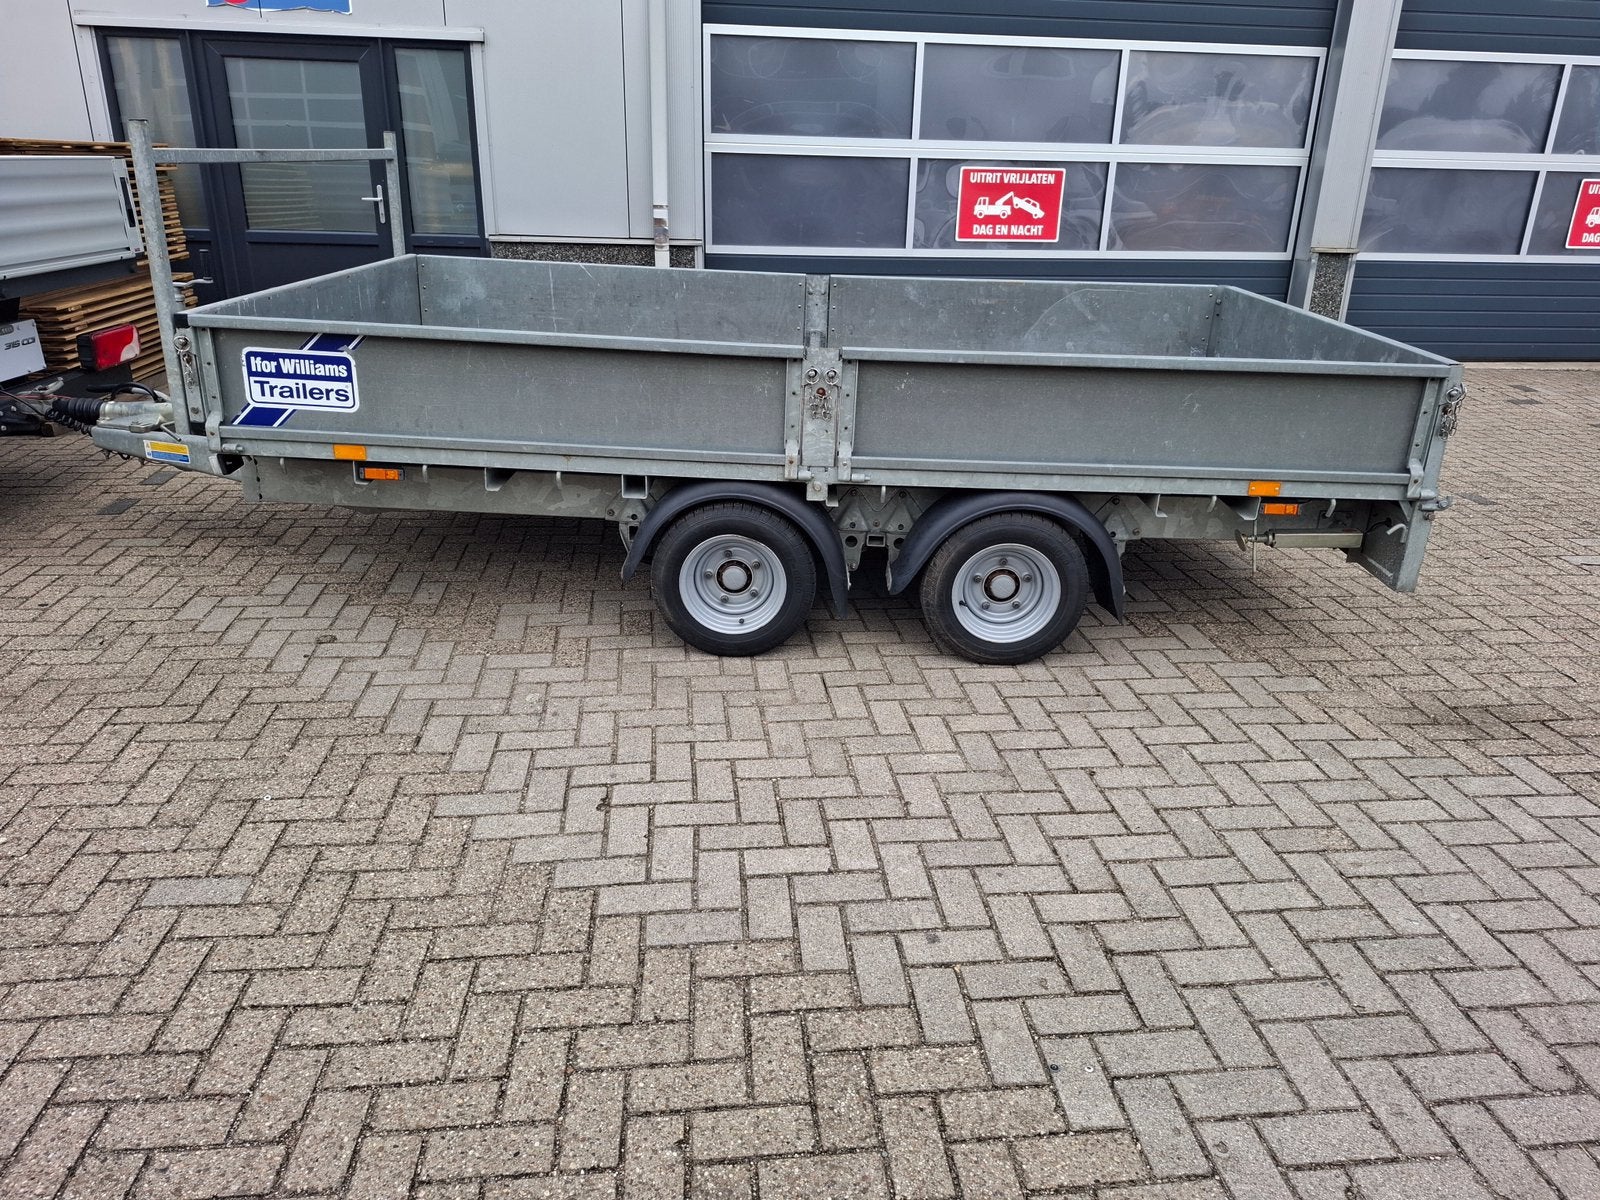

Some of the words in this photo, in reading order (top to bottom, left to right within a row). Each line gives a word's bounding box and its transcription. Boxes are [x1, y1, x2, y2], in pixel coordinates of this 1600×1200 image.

[970, 172, 1002, 183] UITRIT
[1003, 173, 1055, 184] VRIJLATEN
[1588, 184, 1600, 194] UI
[973, 224, 993, 235] DAG
[995, 225, 1008, 235] EN
[1010, 225, 1044, 236] NACHT
[250, 356, 278, 373] Ifor
[278, 358, 348, 377] Williams
[253, 380, 350, 402] Trailers
